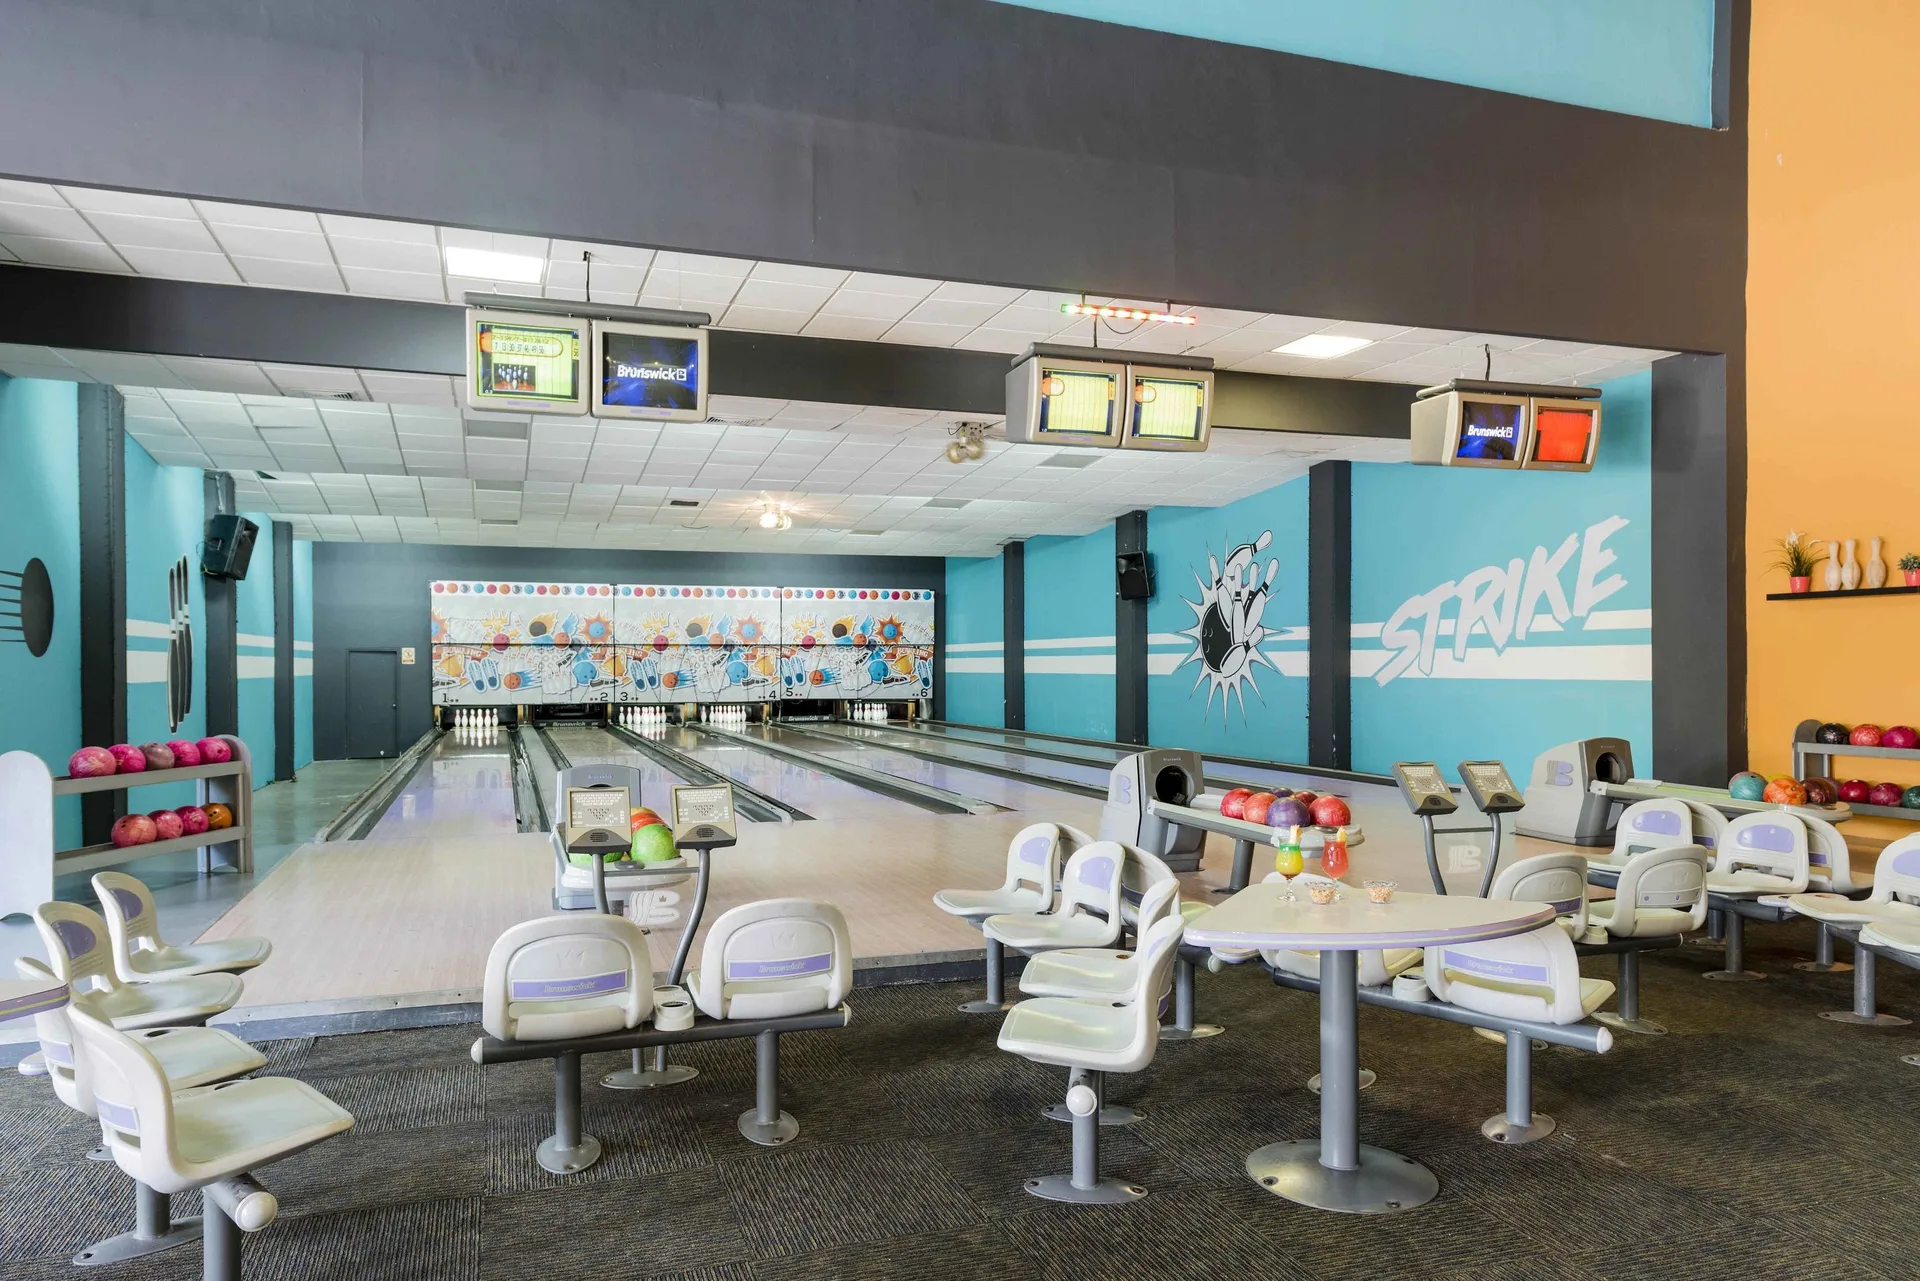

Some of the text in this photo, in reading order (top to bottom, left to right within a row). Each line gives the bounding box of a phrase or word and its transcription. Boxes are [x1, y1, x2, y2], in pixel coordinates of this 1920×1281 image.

[616, 364, 676, 381] Brunswick
[1467, 424, 1506, 438] Brunswick
[1374, 514, 1631, 688] STRIKE
[442, 692, 449, 703] 1
[600, 691, 609, 702] 2
[620, 691, 629, 702] 3
[768, 690, 777, 700] 4
[785, 687, 794, 698] 5
[920, 687, 928, 698] 6
